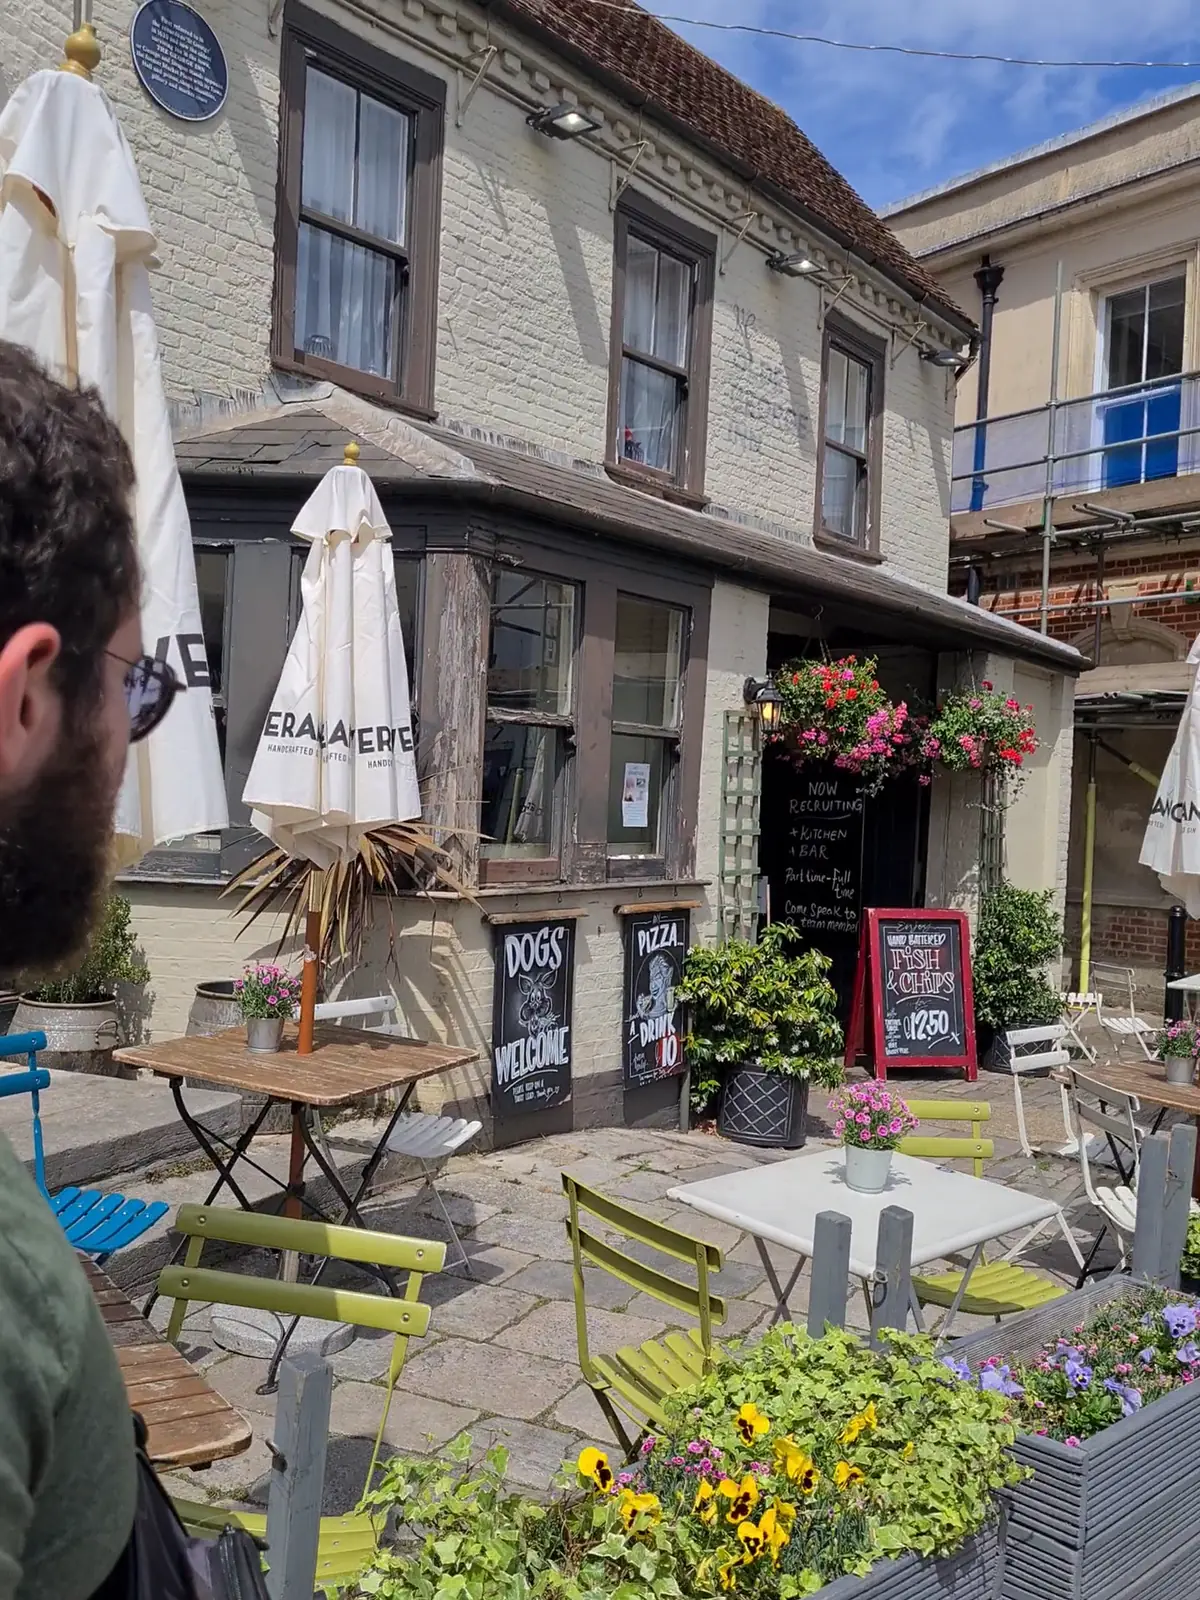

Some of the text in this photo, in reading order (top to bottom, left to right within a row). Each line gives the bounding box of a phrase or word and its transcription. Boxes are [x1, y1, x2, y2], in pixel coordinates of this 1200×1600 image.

[808, 781, 838, 796] NOW
[789, 798, 863, 814] RECRUITING
[800, 824, 847, 841] KITCHEN
[799, 844, 829, 860] BAR
[834, 883, 855, 899] time
[785, 900, 807, 915] Come
[845, 907, 857, 920] to
[887, 934, 946, 946] HAND BATTERED
[505, 927, 564, 978] DOGS
[887, 970, 899, 995] &
[639, 1012, 676, 1048] DRINK
[495, 1026, 568, 1085] WELCOME
